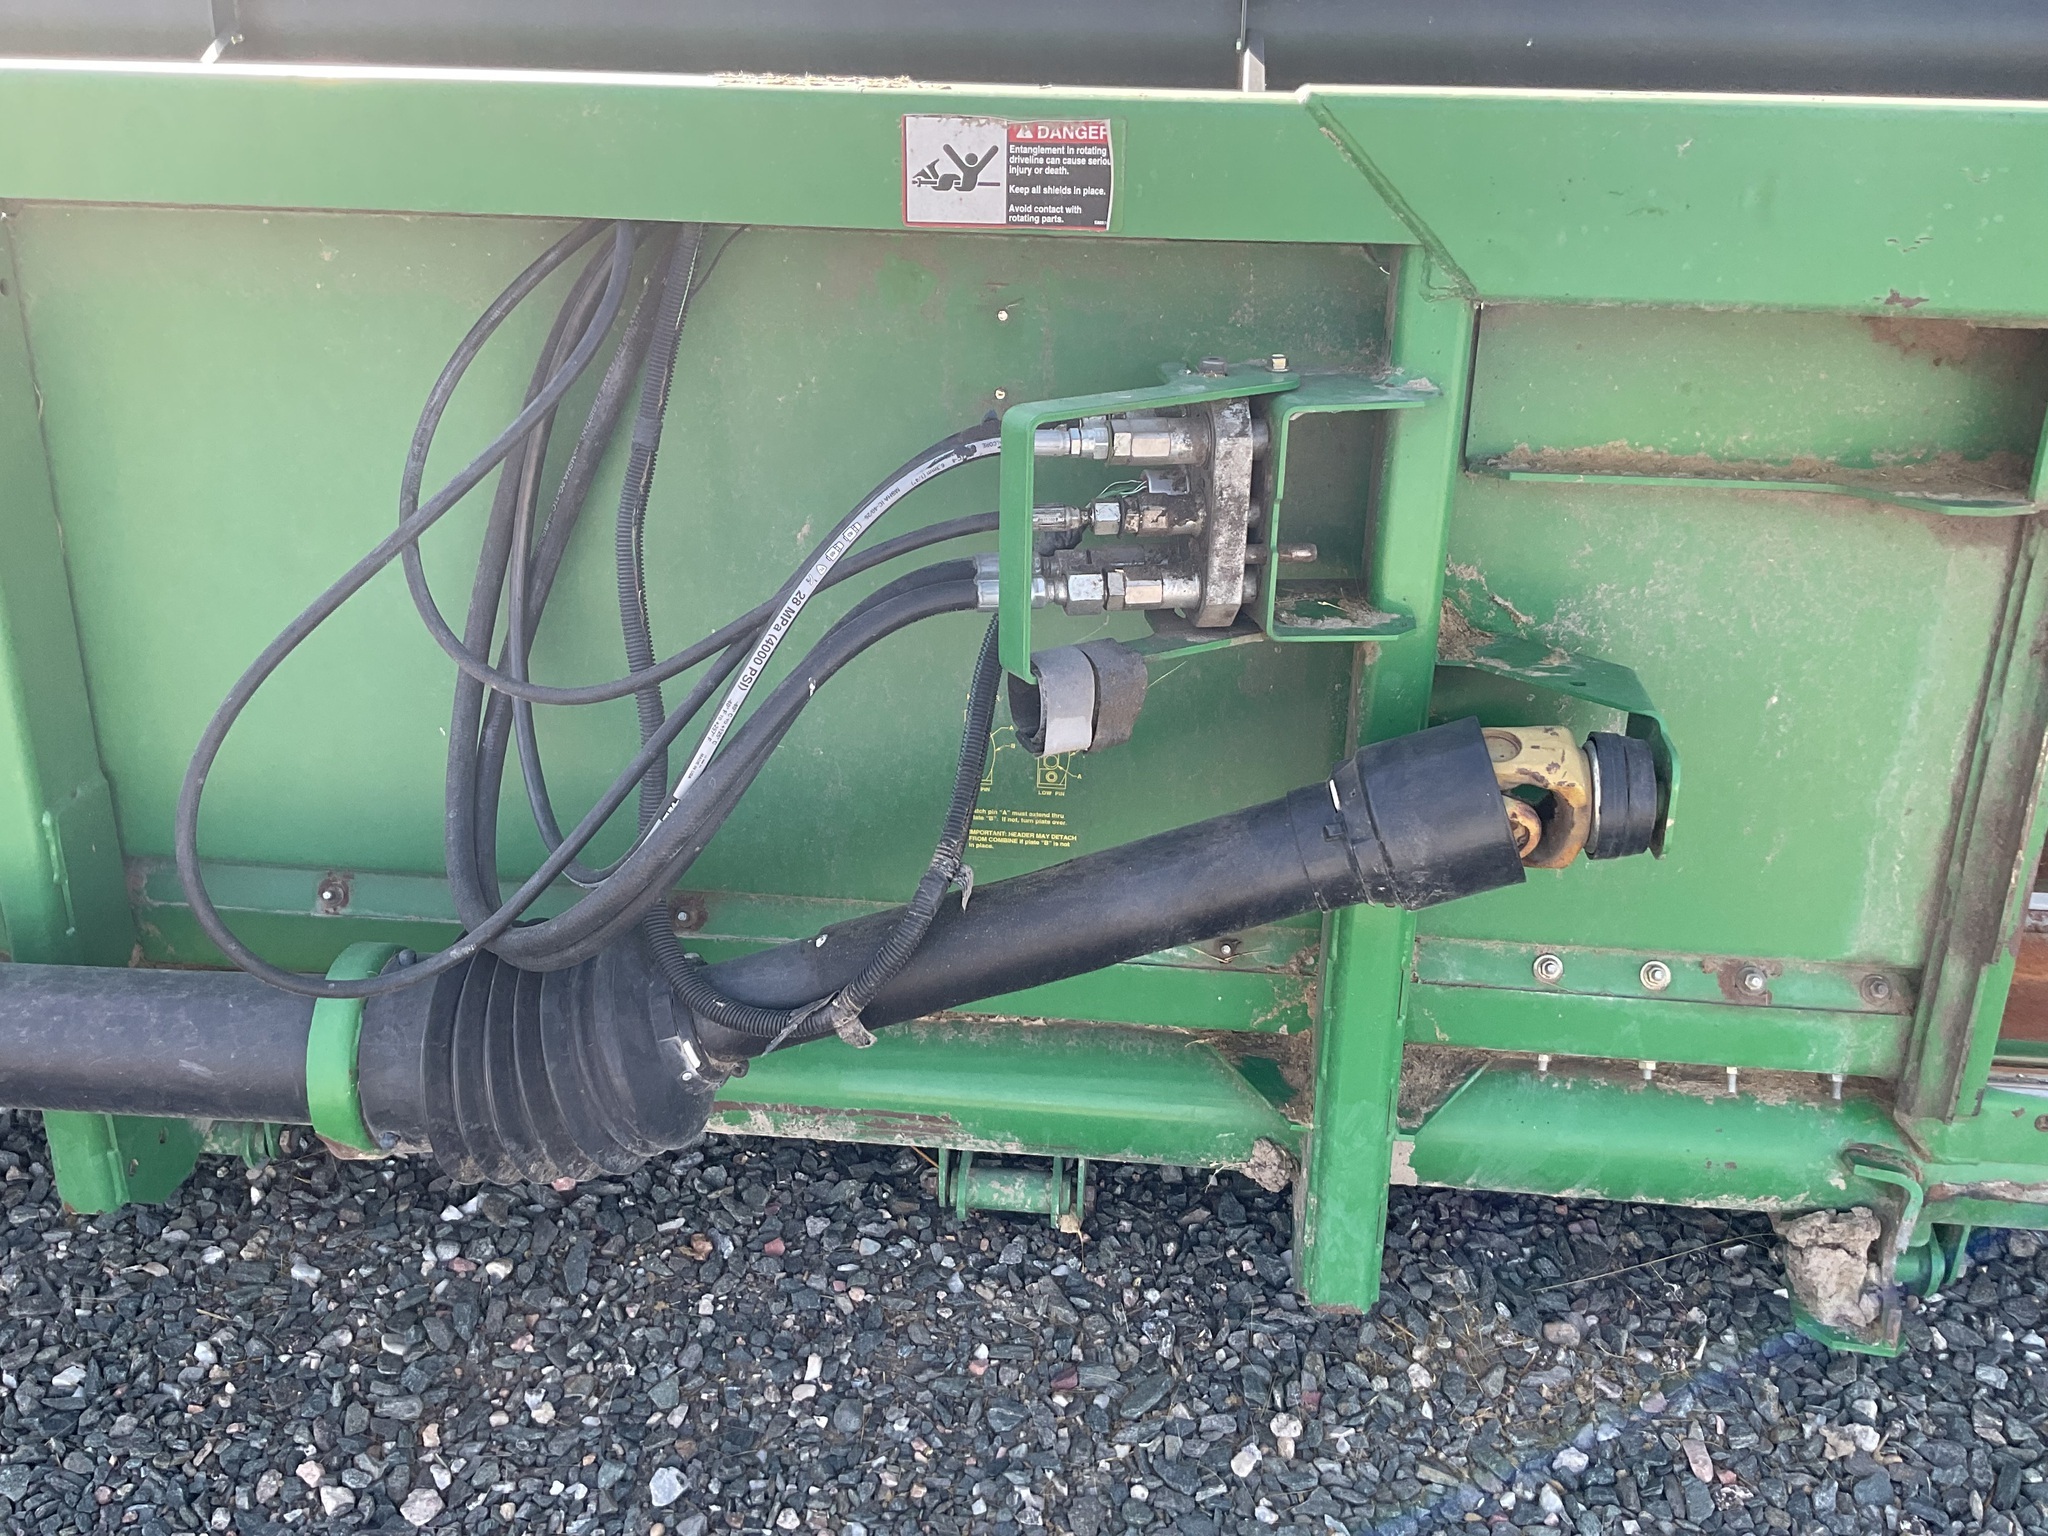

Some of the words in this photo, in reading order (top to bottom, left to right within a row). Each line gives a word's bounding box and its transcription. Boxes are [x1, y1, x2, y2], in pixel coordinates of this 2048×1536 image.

[1009, 145, 1065, 156] Entanglement
[1066, 146, 1075, 154] in
[1076, 146, 1107, 157] rotating
[1009, 155, 1044, 164] driveline
[1088, 157, 1111, 165] seriou
[1009, 165, 1032, 176] injury
[1045, 166, 1069, 175] death.
[1009, 185, 1029, 196] Keep
[1031, 185, 1041, 194] all
[1043, 186, 1072, 194] shields
[1073, 186, 1081, 194] in
[1083, 186, 1106, 196] place.
[1008, 204, 1032, 213] Avoid
[1034, 205, 1064, 213] contact
[1065, 206, 1082, 214] with
[1008, 214, 1040, 224] rotating
[1041, 214, 1064, 224] parts.
[791, 590, 806, 606] 28
[773, 606, 795, 633] MPa
[754, 633, 778, 666] (4000
[738, 666, 757, 691] PSI)
